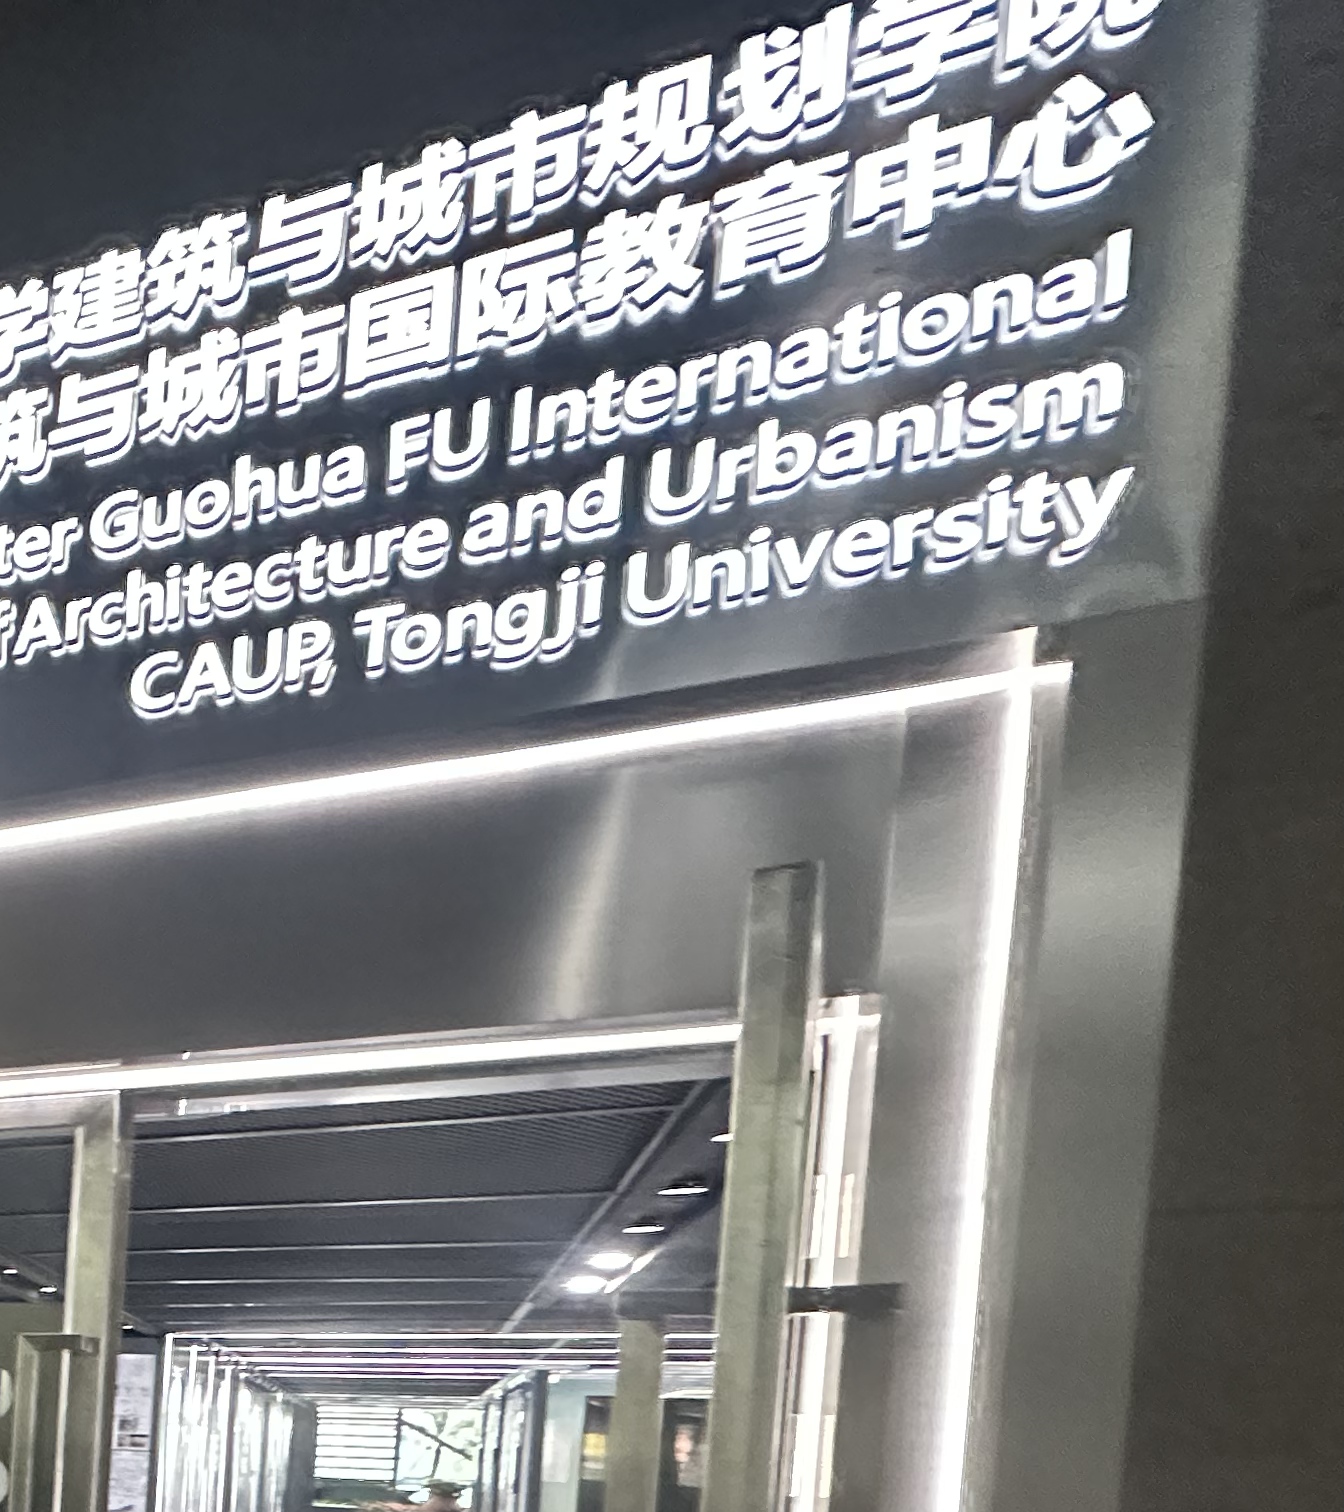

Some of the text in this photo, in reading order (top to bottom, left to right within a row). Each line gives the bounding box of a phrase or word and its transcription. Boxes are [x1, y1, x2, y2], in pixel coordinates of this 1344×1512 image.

[15, 505, 449, 660] Architecture
[461, 455, 623, 567] and
[643, 359, 1128, 535] Urbanism
[90, 444, 368, 563] Guohua
[387, 398, 492, 495] FU
[510, 228, 1135, 466] International
[129, 463, 1136, 721] CAUP, Tongji University
